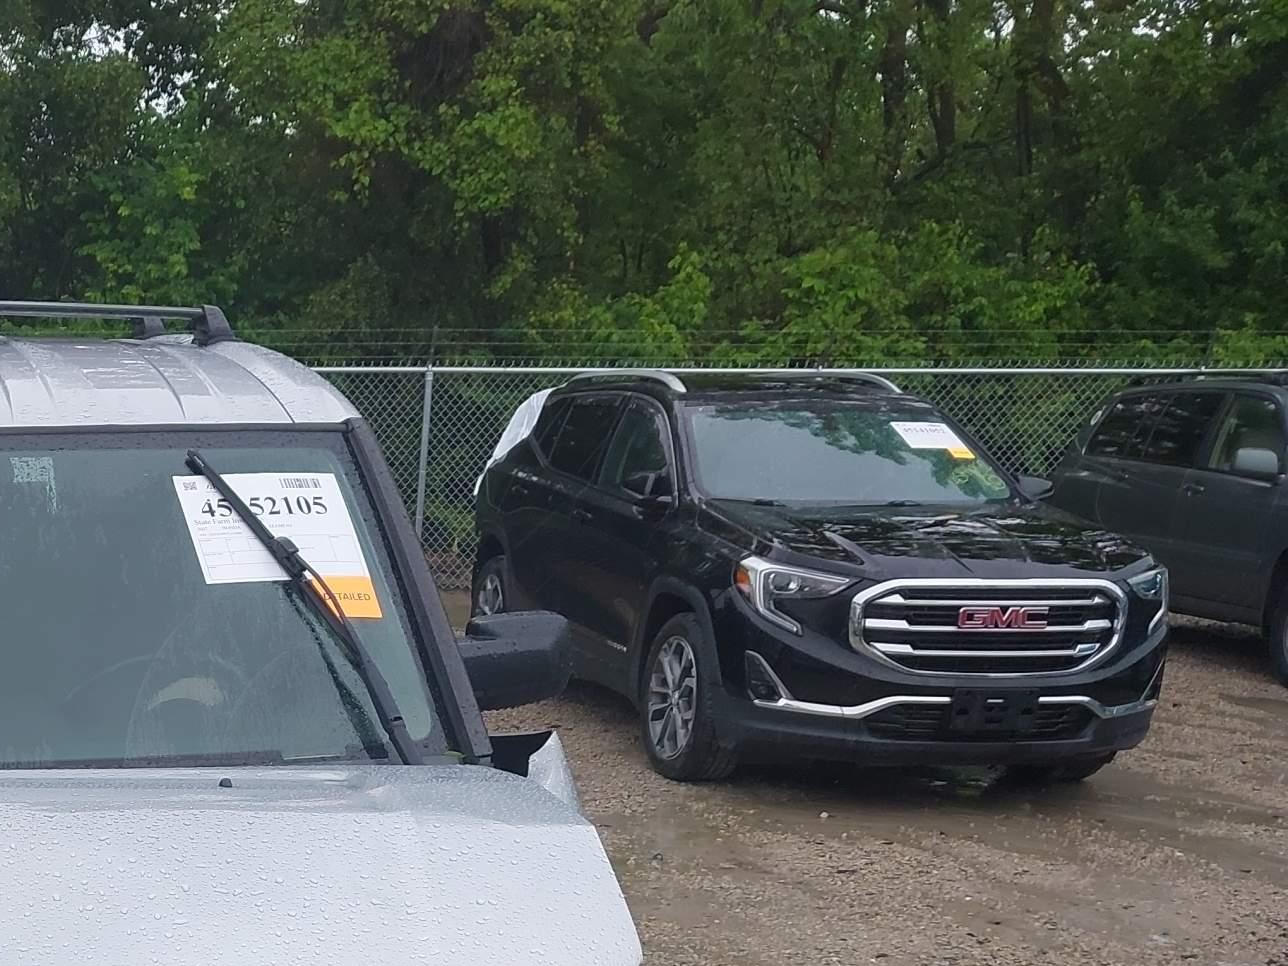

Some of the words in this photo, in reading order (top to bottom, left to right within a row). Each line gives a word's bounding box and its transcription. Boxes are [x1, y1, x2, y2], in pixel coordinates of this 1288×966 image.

[201, 495, 328, 518] 4552105
[323, 592, 371, 602] DTAILED
[958, 606, 1050, 629] GMC
